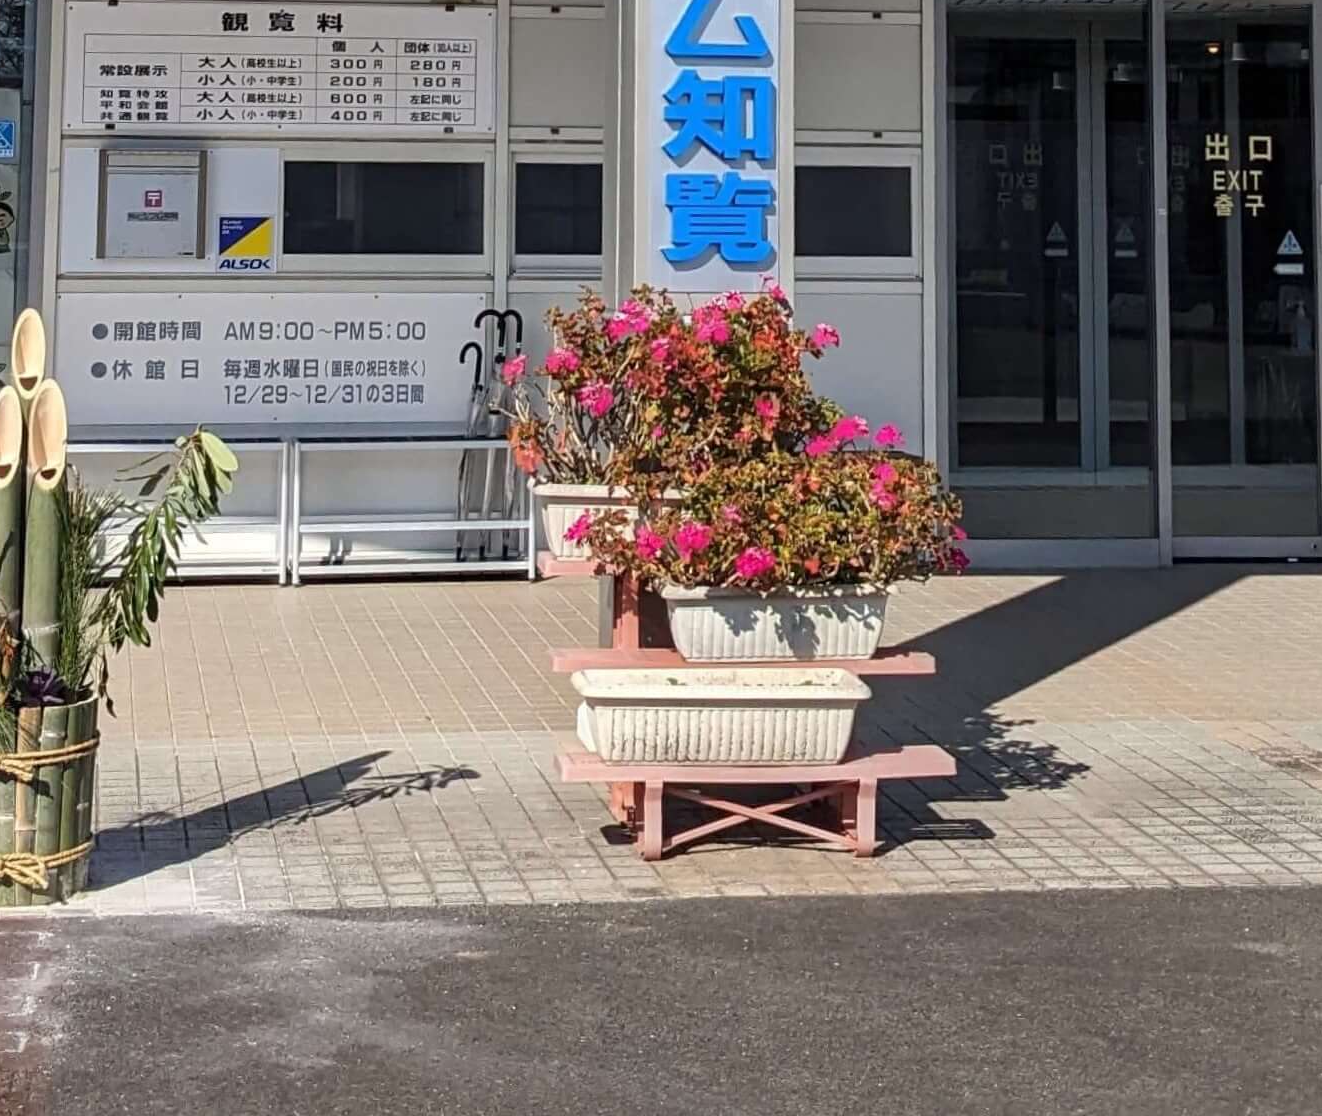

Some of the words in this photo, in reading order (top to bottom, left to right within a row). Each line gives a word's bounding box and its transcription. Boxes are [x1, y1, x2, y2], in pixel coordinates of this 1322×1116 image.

[221, 11, 344, 33] 観覧料
[99, 64, 168, 77] 常設展示
[1204, 132, 1273, 162] 出口
[1212, 171, 1264, 192] EXIT
[1213, 195, 1266, 218] 출구
[219, 258, 271, 270] ALSOK
[112, 321, 202, 342] 開館時間
[112, 359, 200, 380] 休館日
